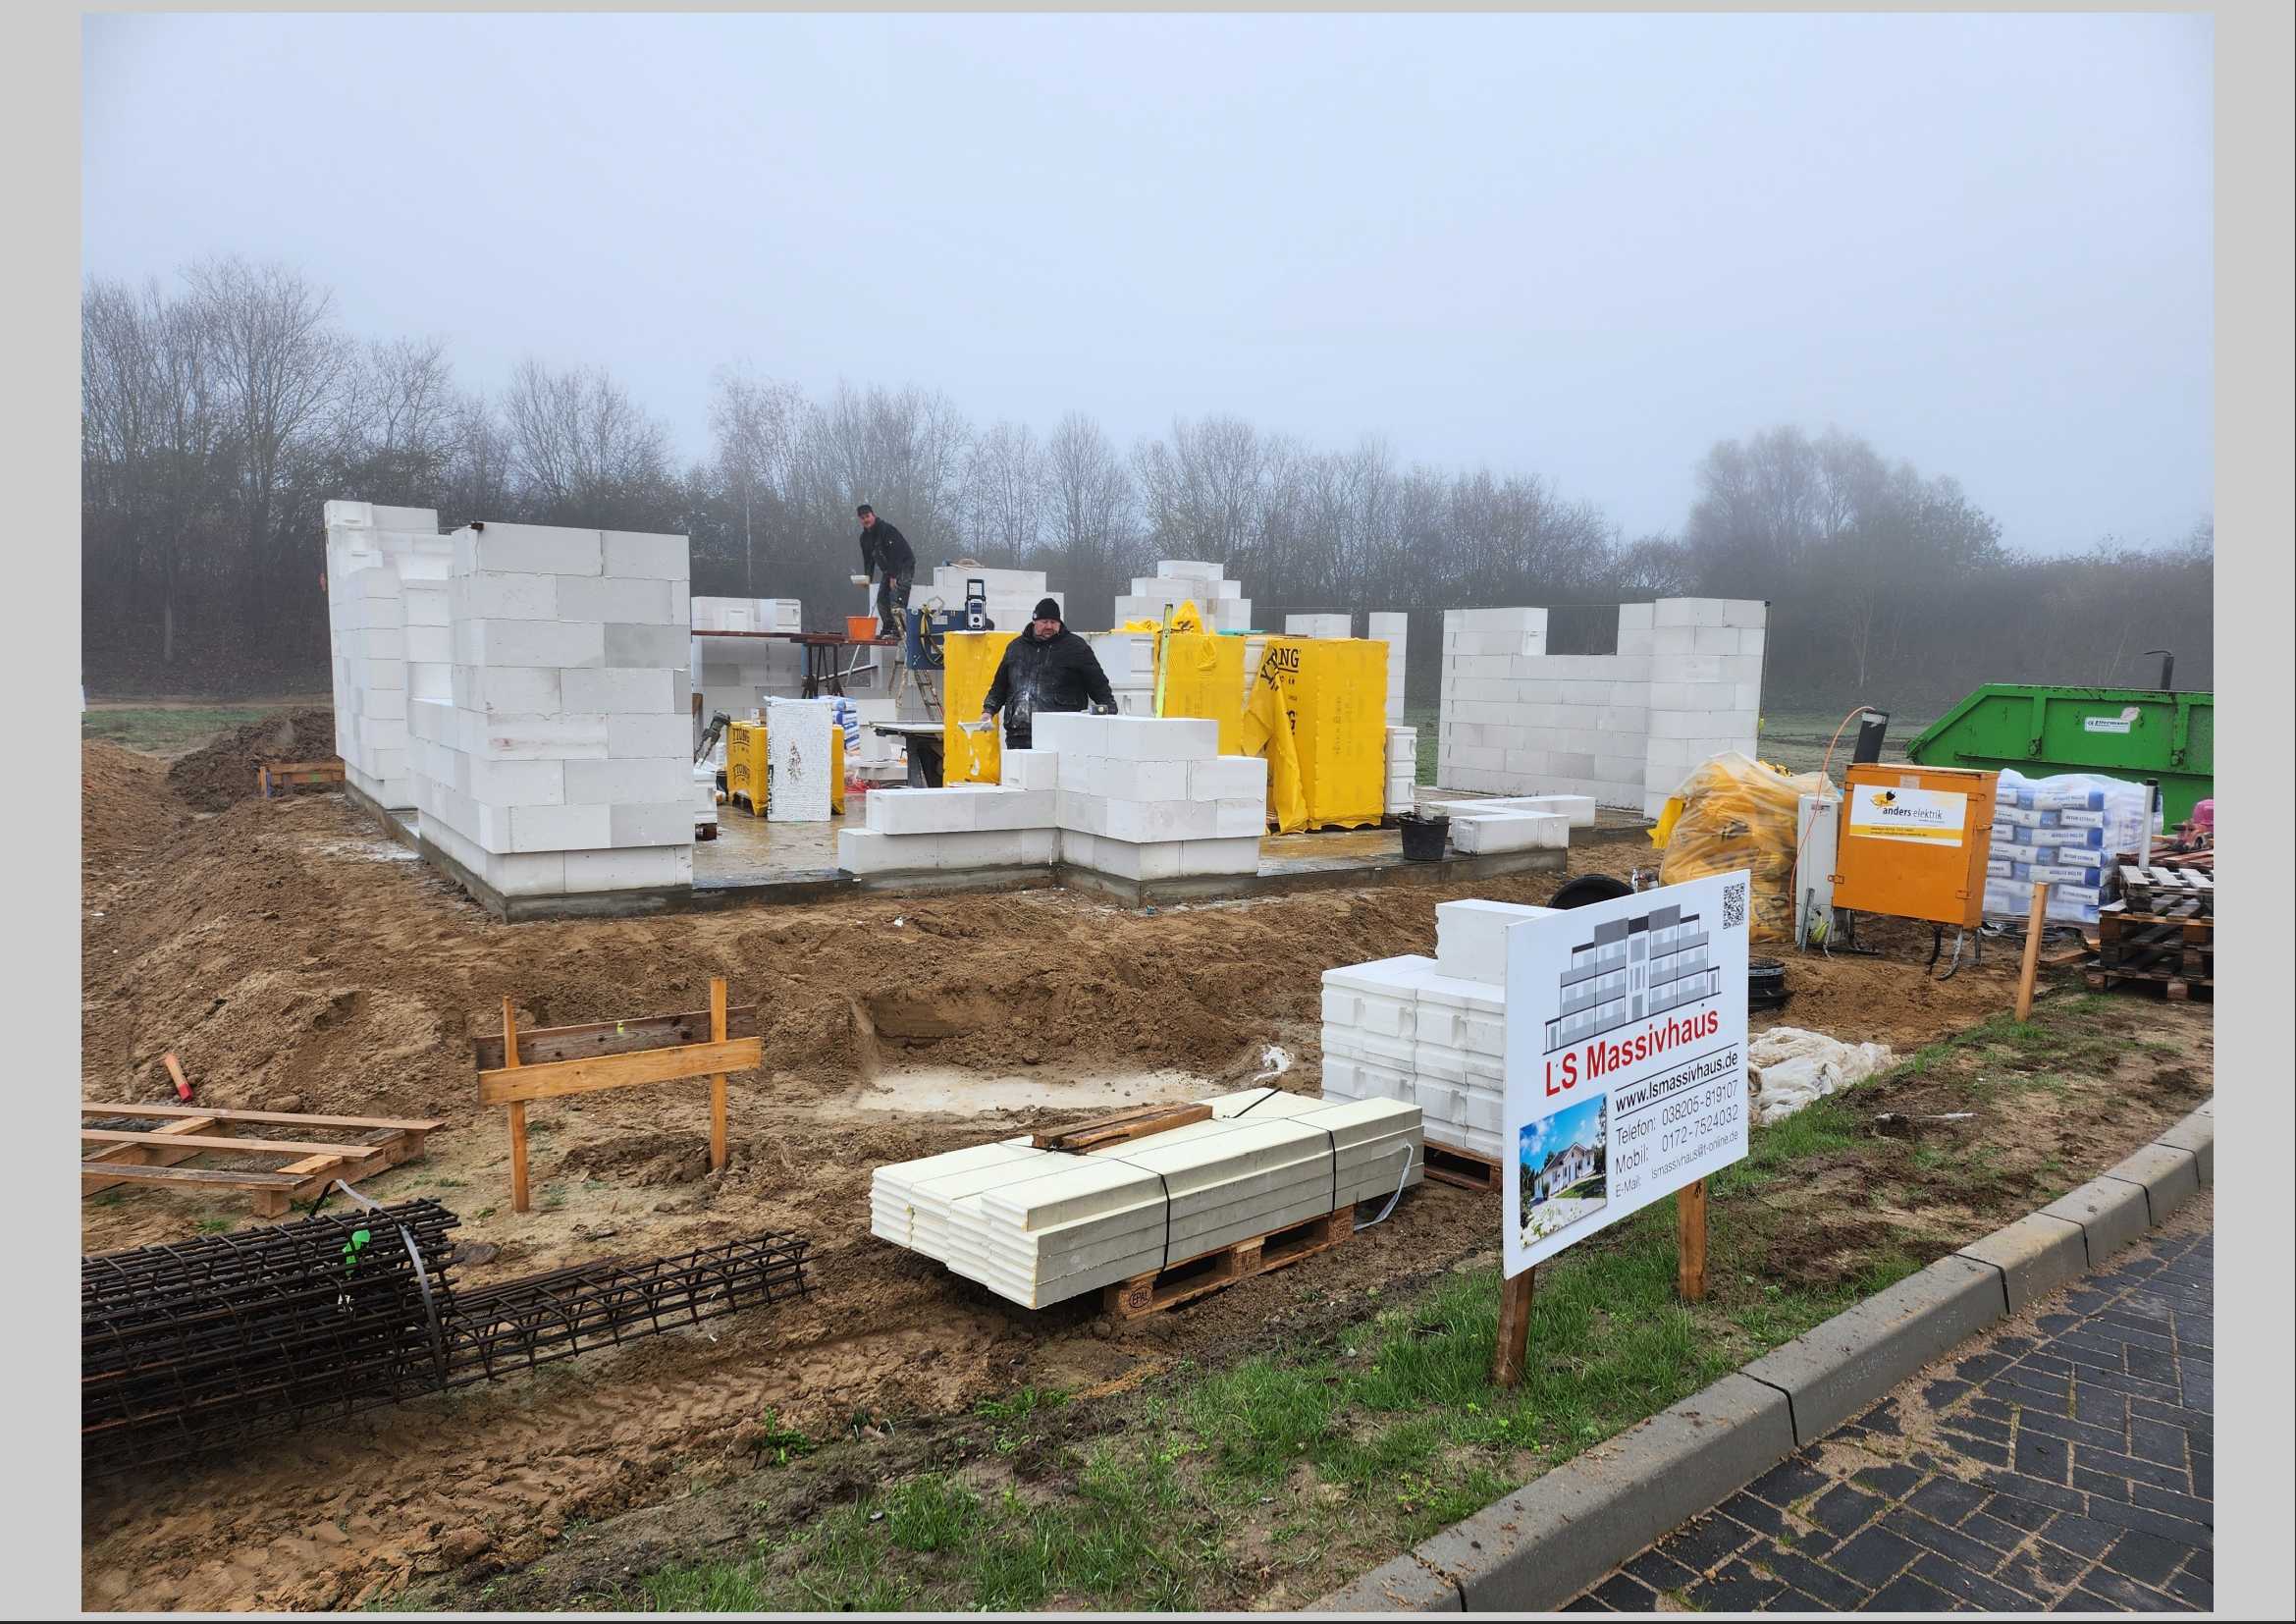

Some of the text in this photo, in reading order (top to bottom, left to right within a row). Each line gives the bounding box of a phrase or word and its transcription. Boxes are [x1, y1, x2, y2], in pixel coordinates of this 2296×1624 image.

[1883, 807, 1943, 820] anders elektrik
[1546, 1009, 1719, 1097] LS Massivhaus
[1616, 1052, 1738, 1112] www.lsmassivhaus.de
[1616, 1116, 1656, 1147] Telefon:
[1616, 1143, 1649, 1175] Mobil:
